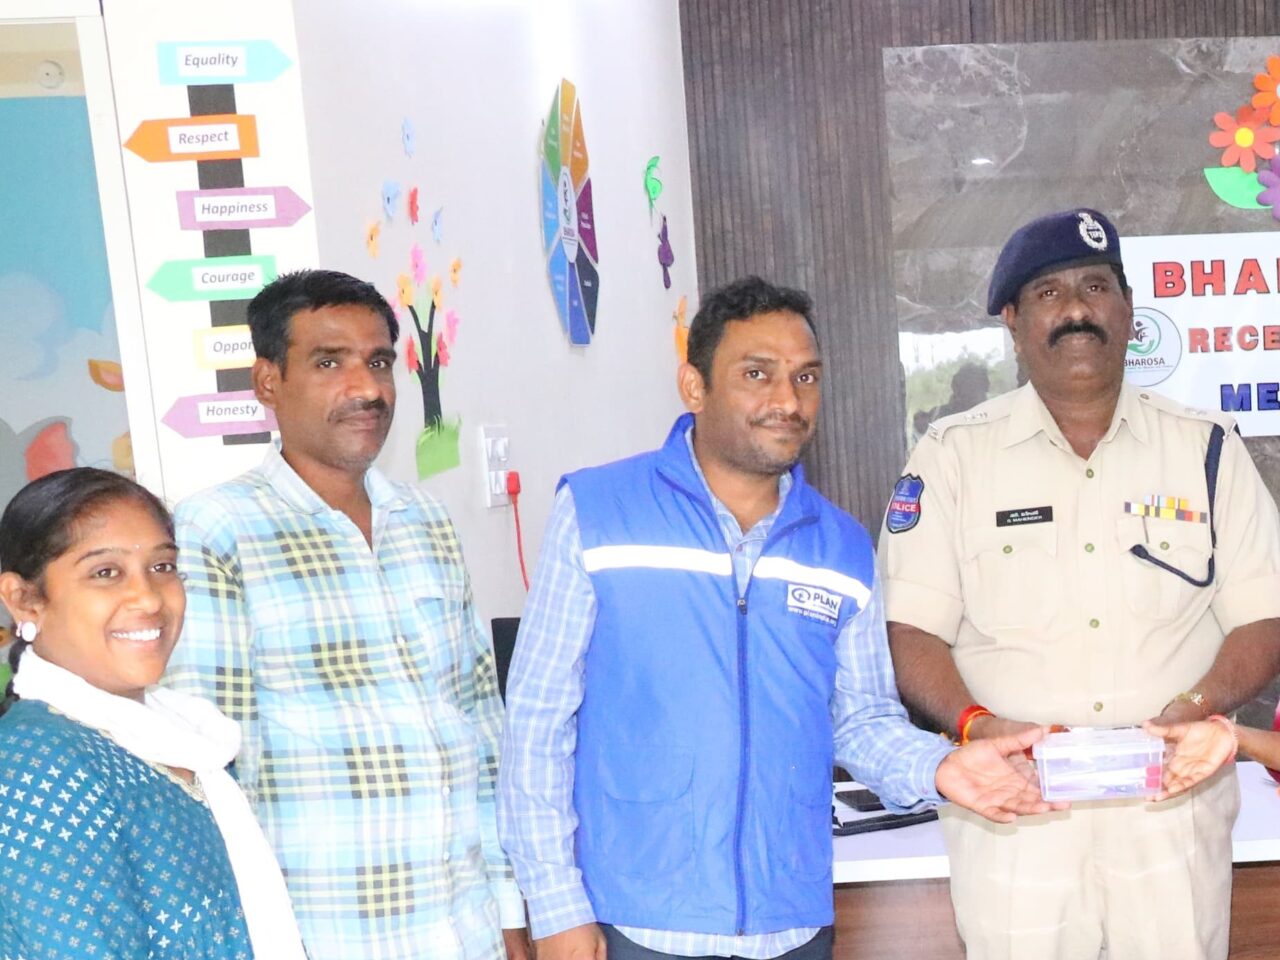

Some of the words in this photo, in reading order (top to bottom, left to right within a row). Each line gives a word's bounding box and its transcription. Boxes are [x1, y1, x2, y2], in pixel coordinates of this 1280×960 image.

[184, 53, 239, 69] Equality
[178, 130, 230, 148] Respect
[201, 200, 269, 218] Happiness
[201, 270, 255, 288] Courage
[213, 341, 253, 355] Oppor
[1124, 357, 1166, 367] BHAROSA
[206, 403, 258, 419] Honesty
[813, 592, 839, 611] PLAN
